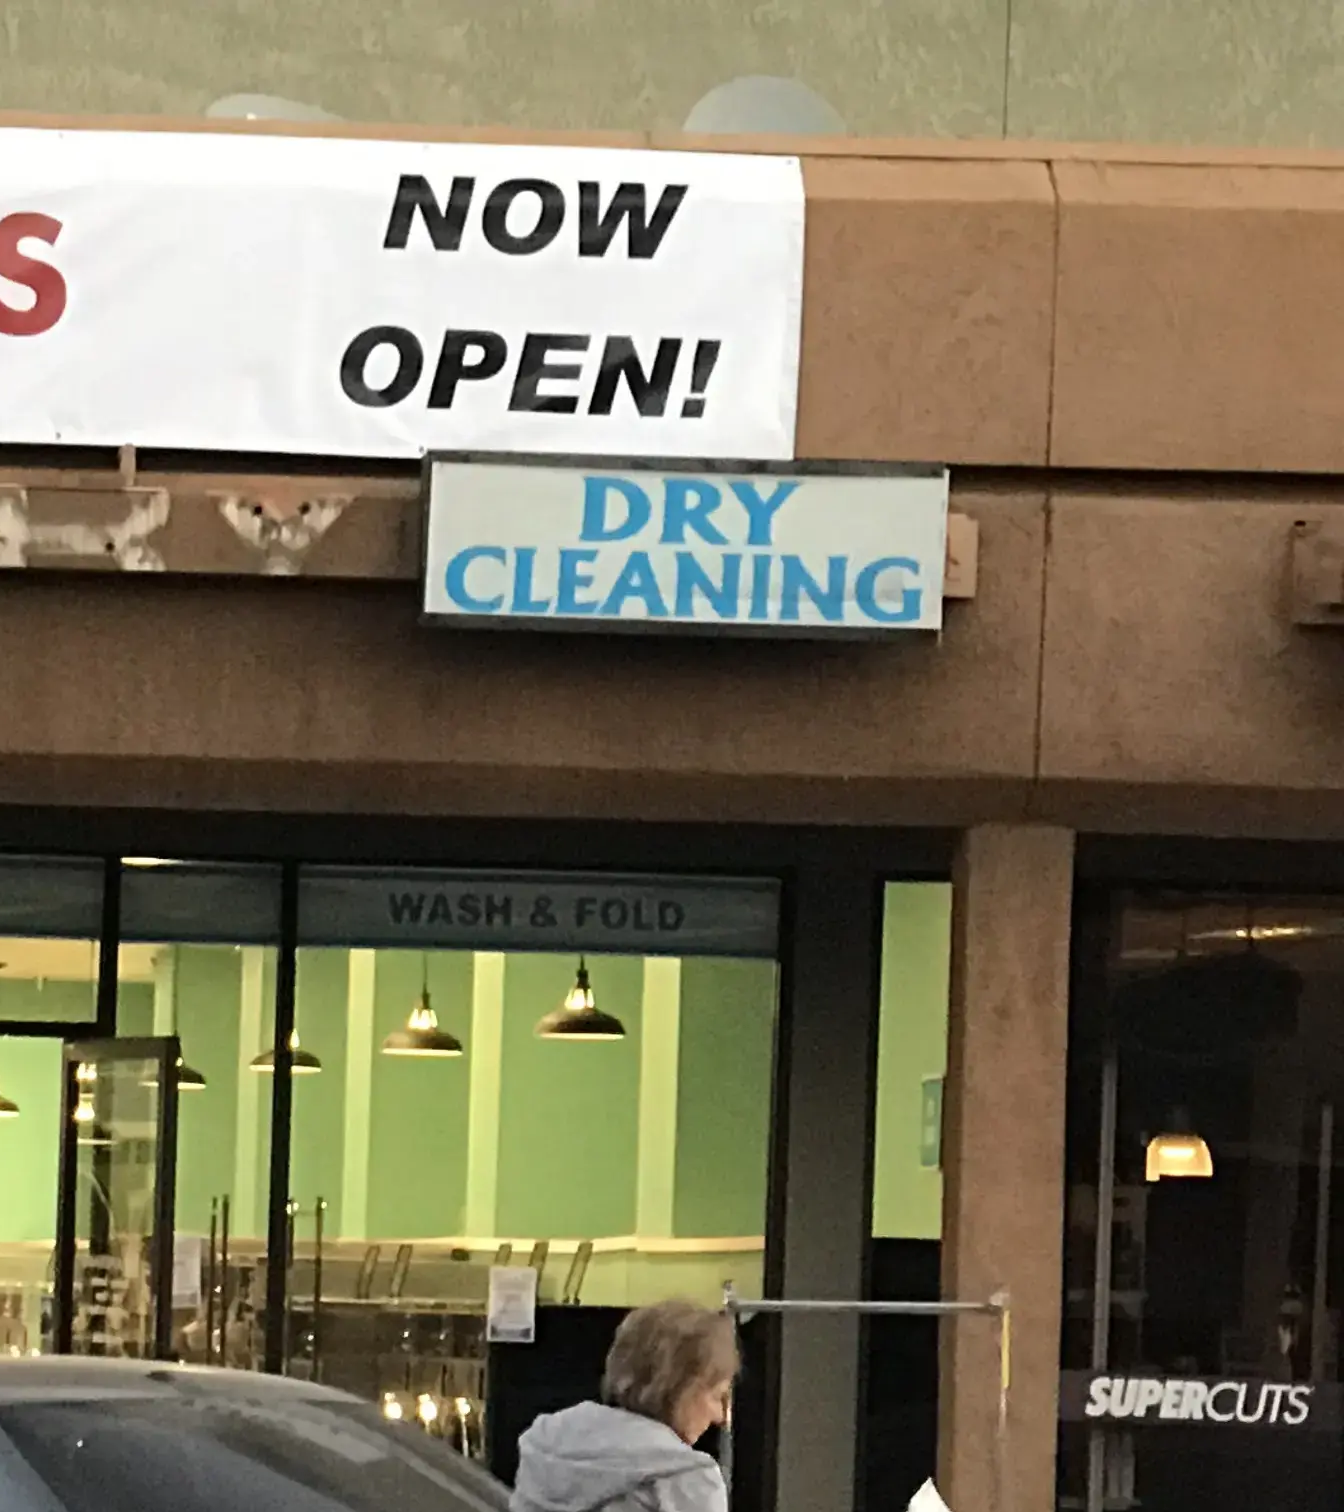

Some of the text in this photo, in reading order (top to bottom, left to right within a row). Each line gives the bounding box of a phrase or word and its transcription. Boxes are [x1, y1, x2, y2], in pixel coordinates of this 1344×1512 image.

[382, 173, 689, 260] NOW
[339, 324, 722, 419] OPEN!
[578, 475, 800, 547] DRY
[444, 543, 922, 624] CLEANING
[389, 892, 685, 932] WASH & FOLD
[1084, 1375, 1312, 1426] SUPERCUTS
